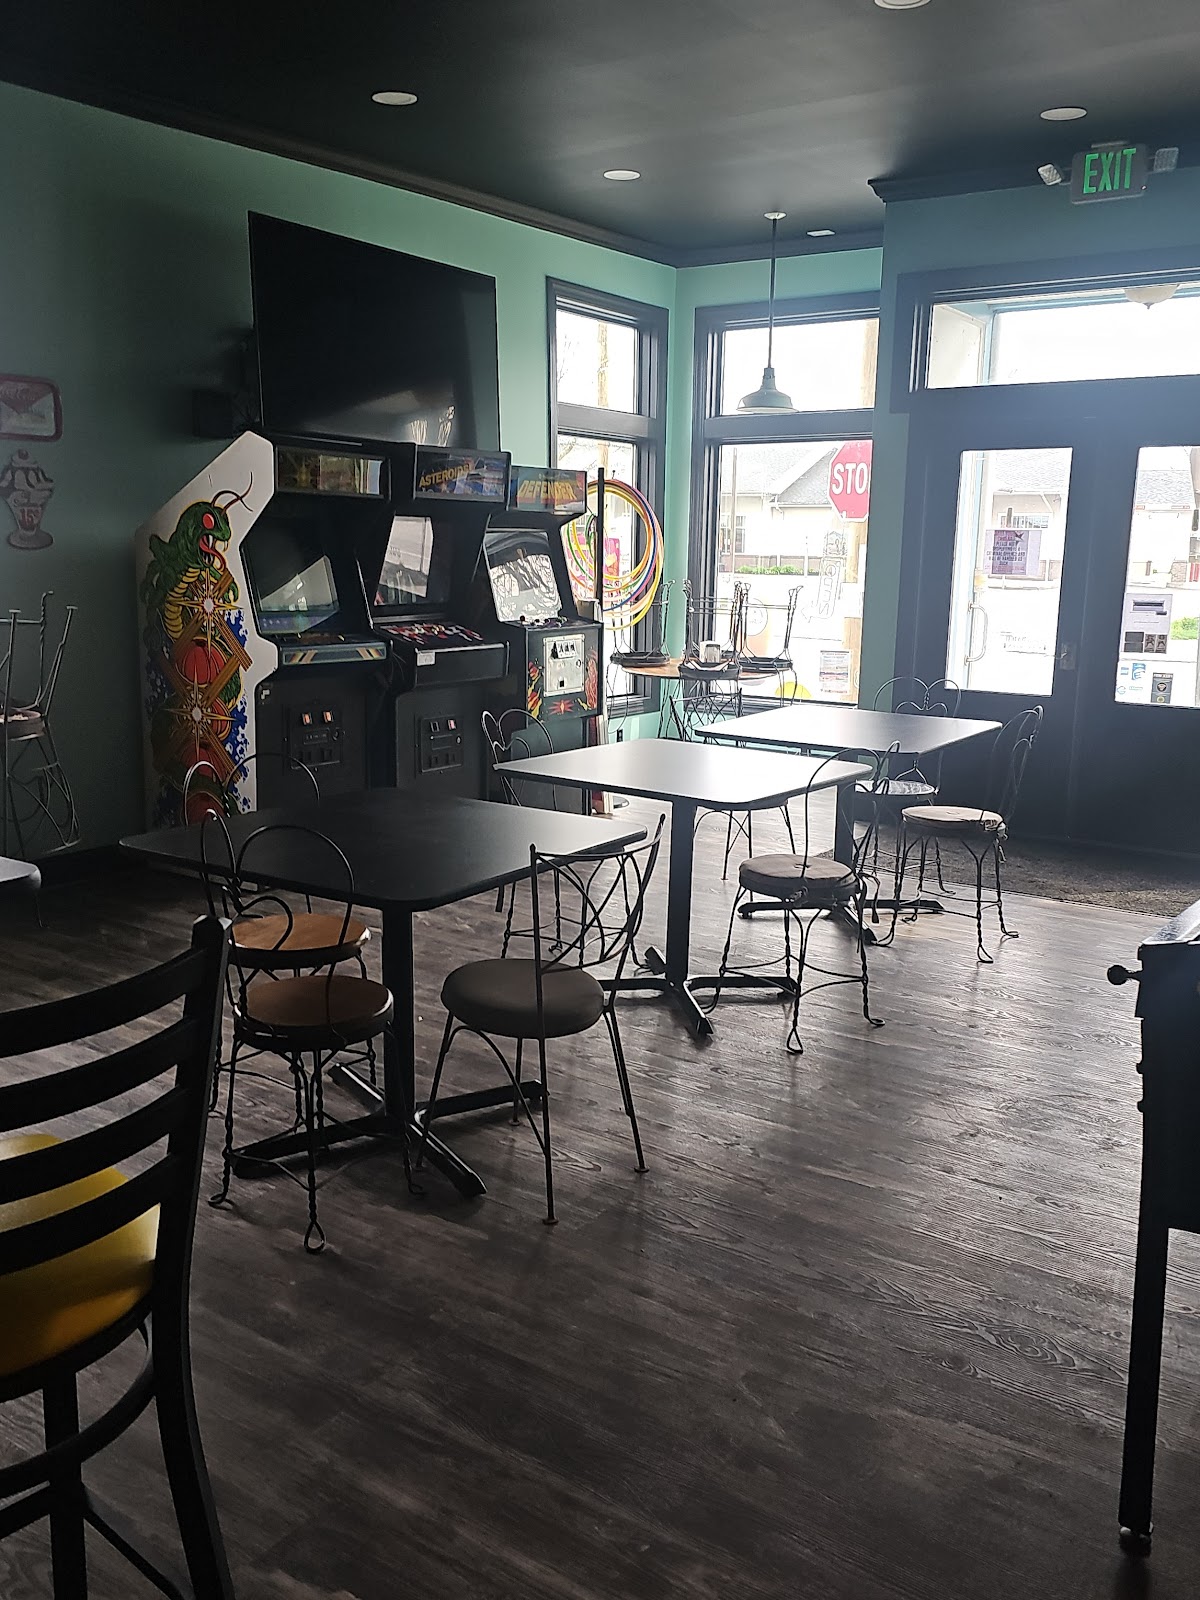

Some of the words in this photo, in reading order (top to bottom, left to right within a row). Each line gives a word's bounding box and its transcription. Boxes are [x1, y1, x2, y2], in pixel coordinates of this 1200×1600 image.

[1083, 148, 1137, 194] EXIT
[518, 479, 577, 502] DEFENDER
[832, 461, 869, 496] STO
